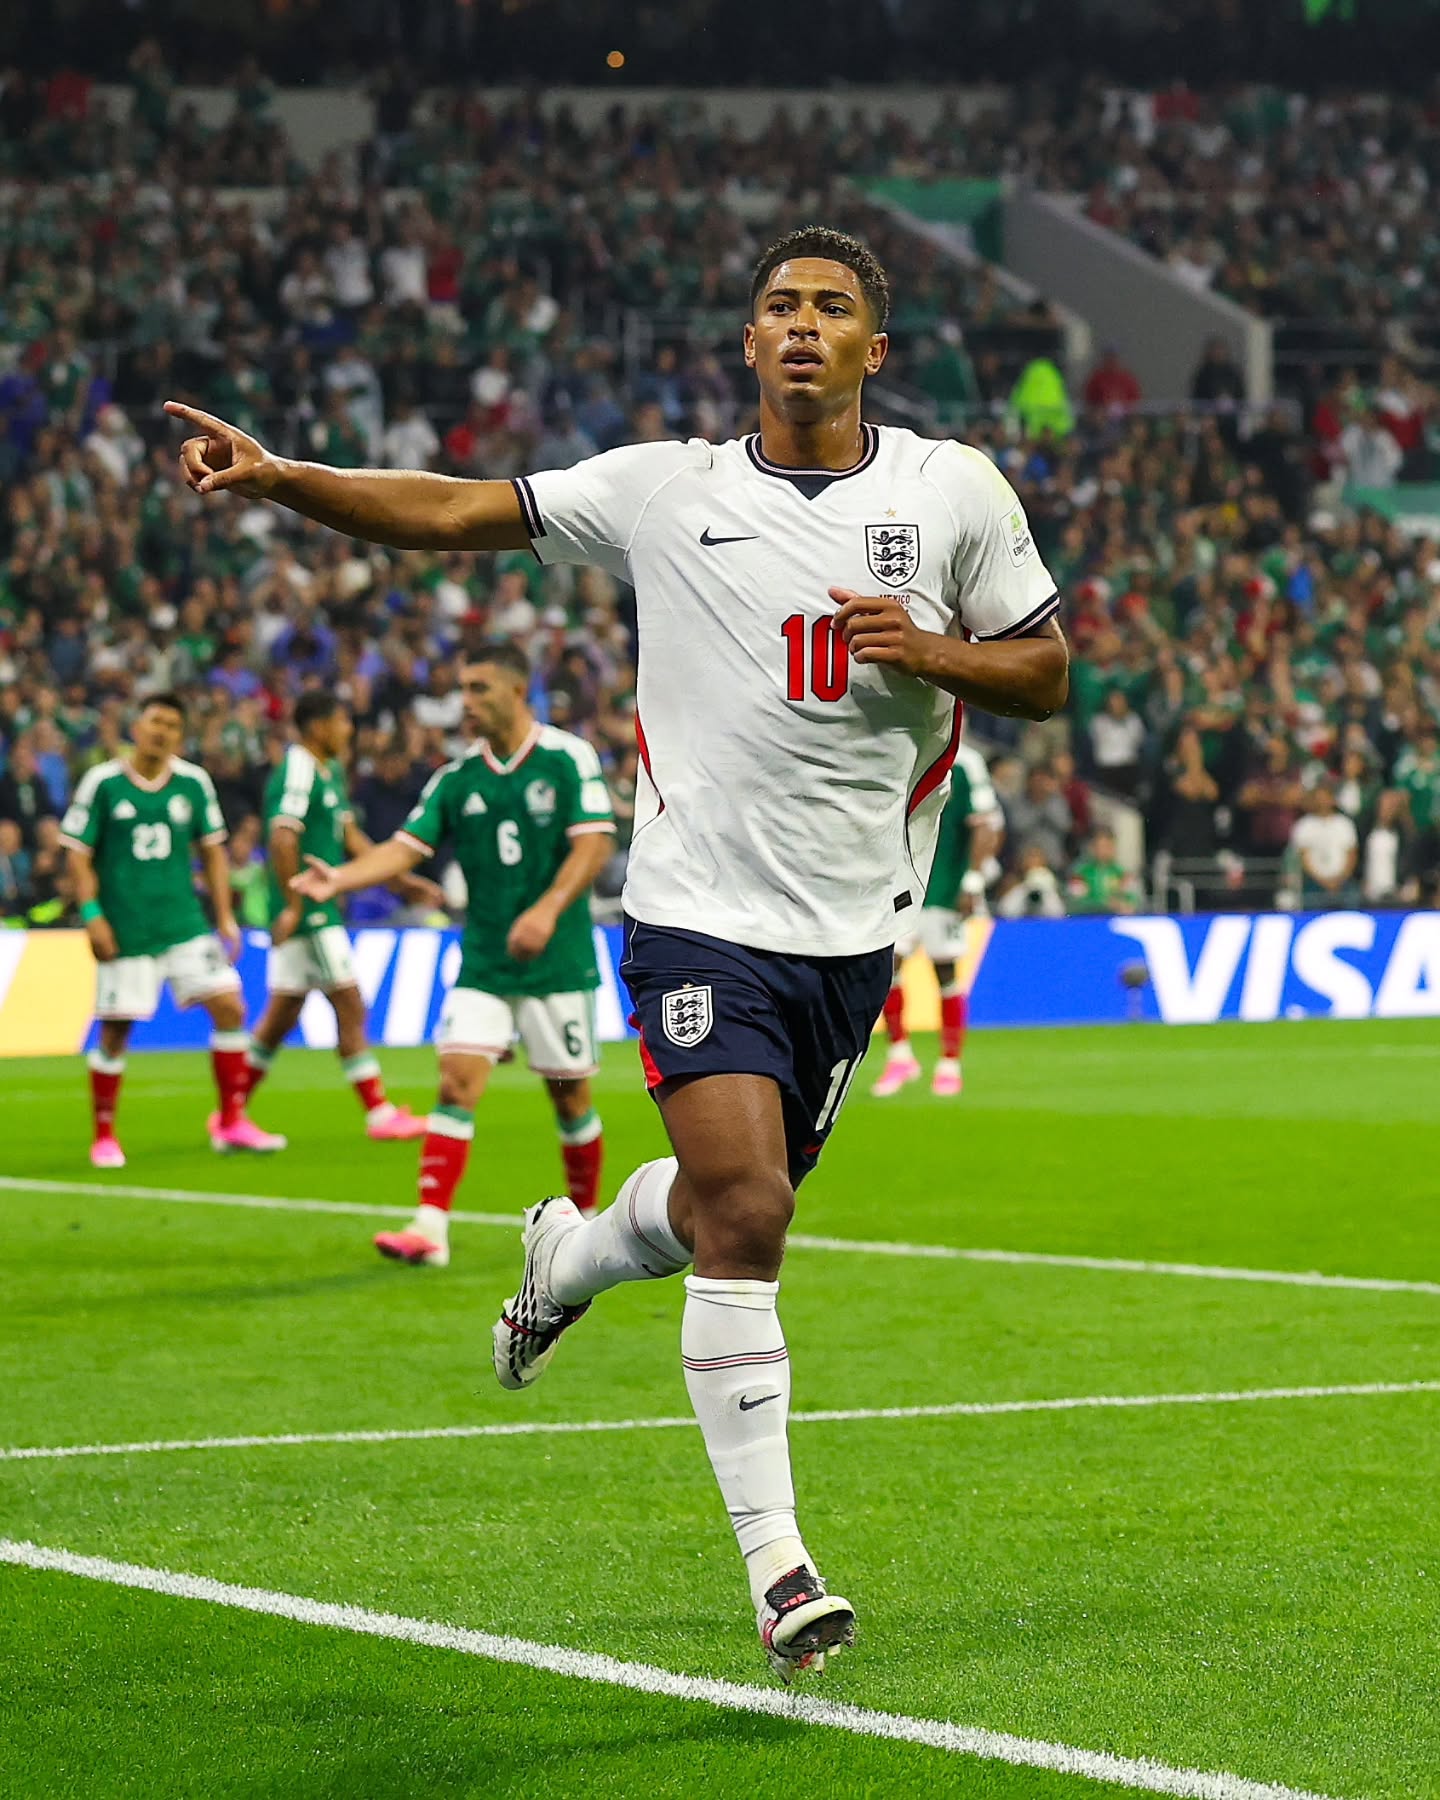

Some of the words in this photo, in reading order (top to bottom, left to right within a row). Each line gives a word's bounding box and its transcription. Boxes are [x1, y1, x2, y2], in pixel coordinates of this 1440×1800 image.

[781, 614, 848, 702] 10
[132, 822, 171, 861] 23
[497, 819, 522, 866] 6
[1108, 911, 1440, 1025] VISA
[564, 1020, 582, 1057] 6
